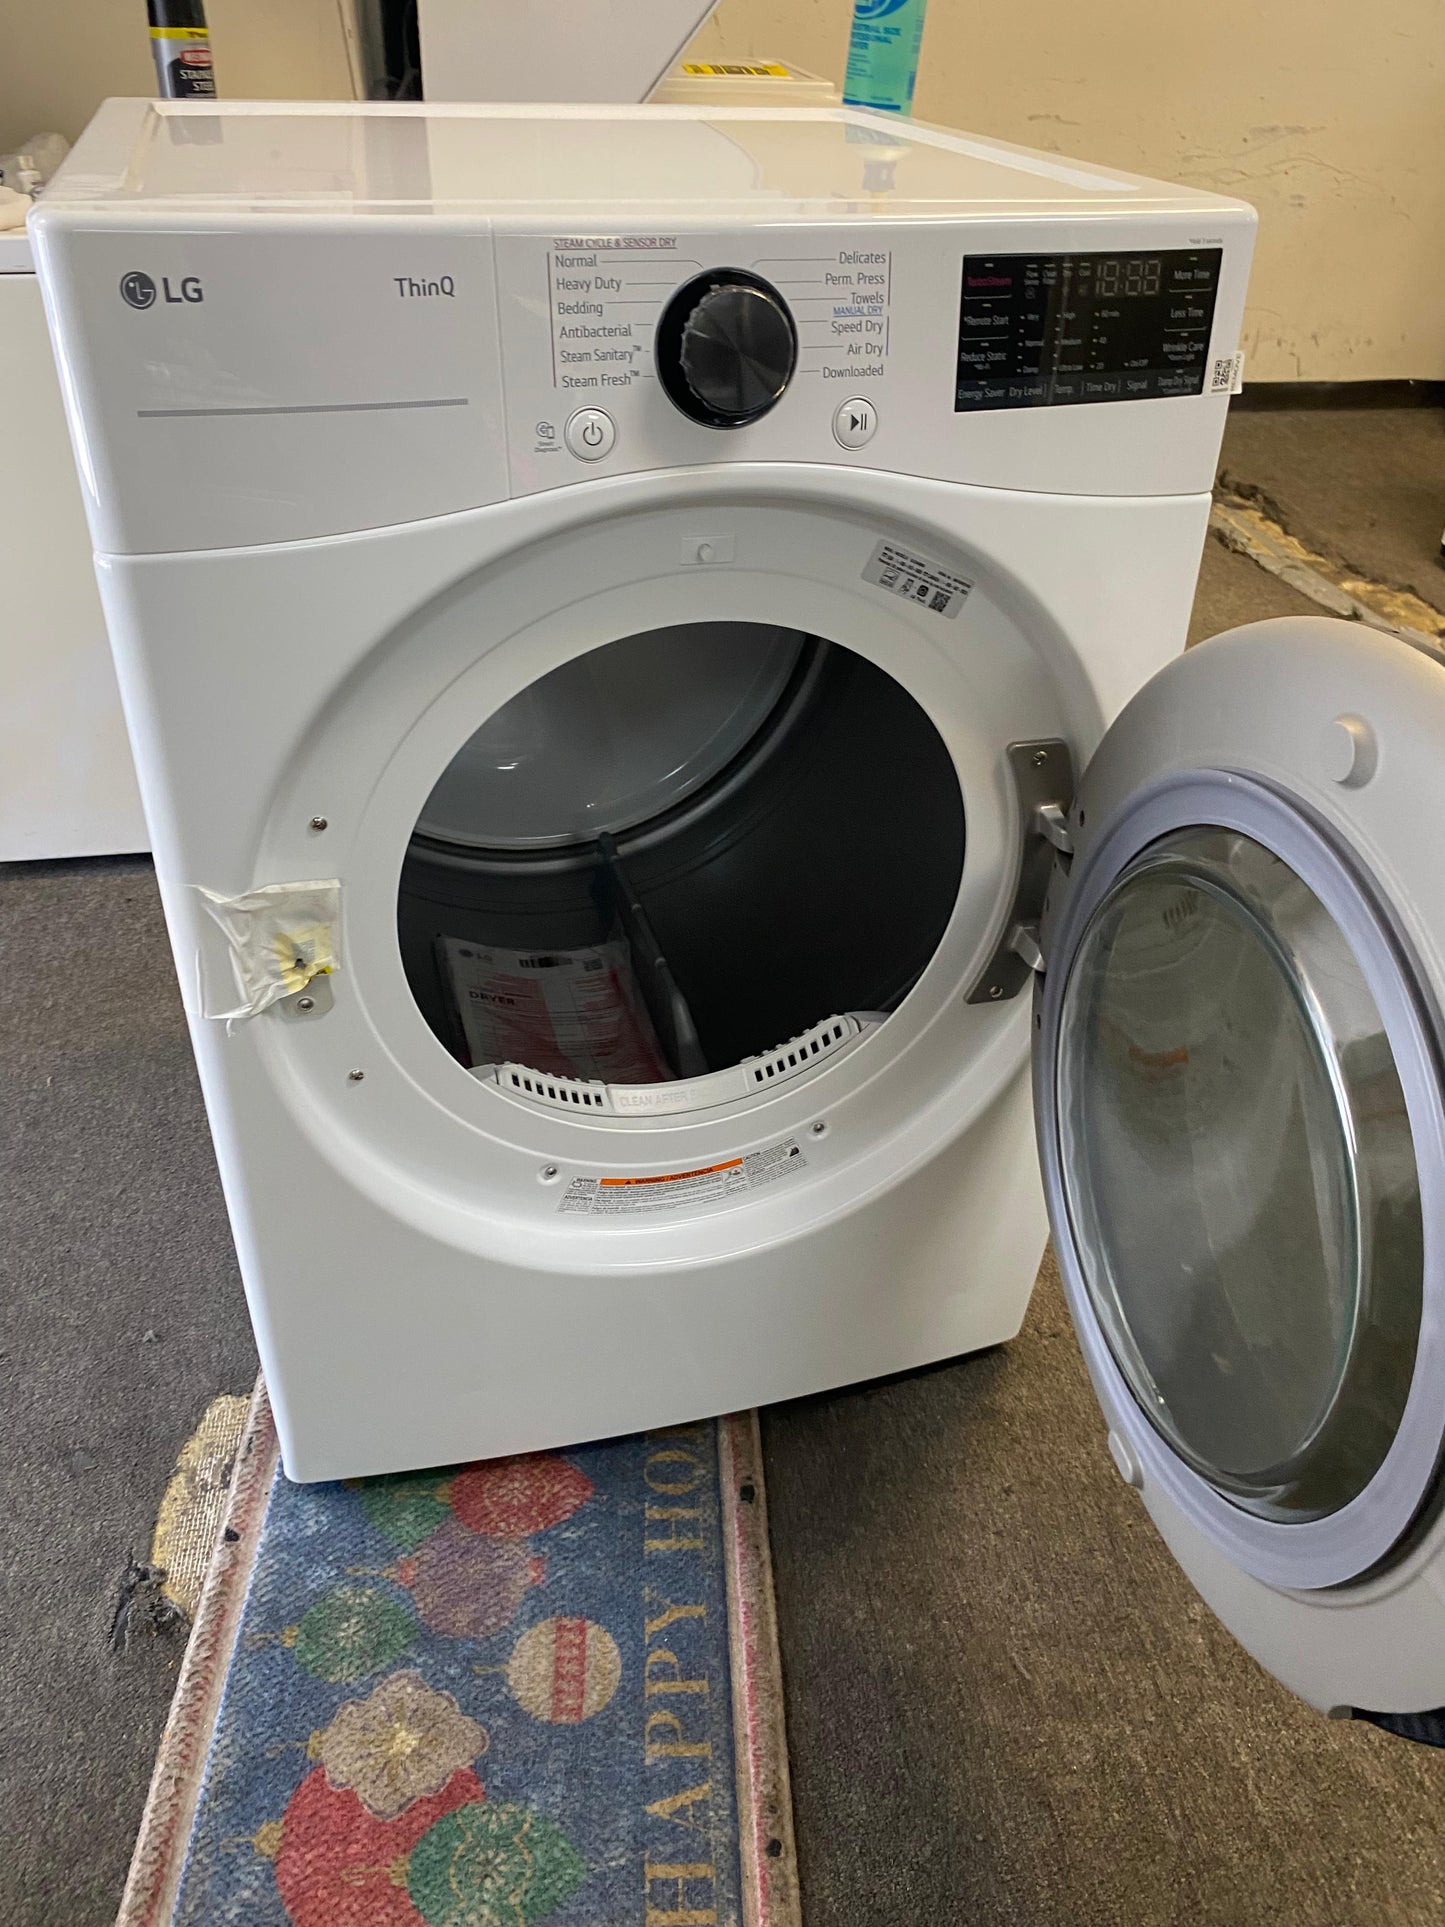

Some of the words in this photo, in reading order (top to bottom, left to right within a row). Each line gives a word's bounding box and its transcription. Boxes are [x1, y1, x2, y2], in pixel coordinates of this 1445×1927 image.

[554, 238, 584, 248] STEAM
[586, 238, 612, 248] CYCLE
[614, 238, 621, 247] &
[623, 237, 657, 248] SENSOR
[659, 237, 677, 247] DRY
[555, 254, 597, 267] Normal
[839, 251, 886, 264] Delicates
[556, 277, 591, 293] Heavy
[594, 276, 622, 292] Duty
[825, 272, 854, 285] Perm.
[857, 272, 885, 285] Press
[163, 276, 203, 303] LG
[393, 275, 456, 298] ThinQ
[851, 292, 884, 304] Towels
[558, 302, 603, 317] Bedding
[833, 306, 865, 315] MANUAL
[867, 306, 883, 315] DRY
[560, 324, 632, 339] Antibacterial
[831, 320, 862, 336] Speed
[865, 320, 883, 335] Dry
[560, 350, 591, 363] Steam
[847, 343, 862, 355] Air
[865, 343, 883, 357] Dry
[823, 365, 884, 379] Downloaded
[562, 376, 597, 388] Steam
[1008, 387, 1023, 399] Dry
[469, 990, 516, 1006] DRYER
[643, 1582, 717, 1927] HAPPY
